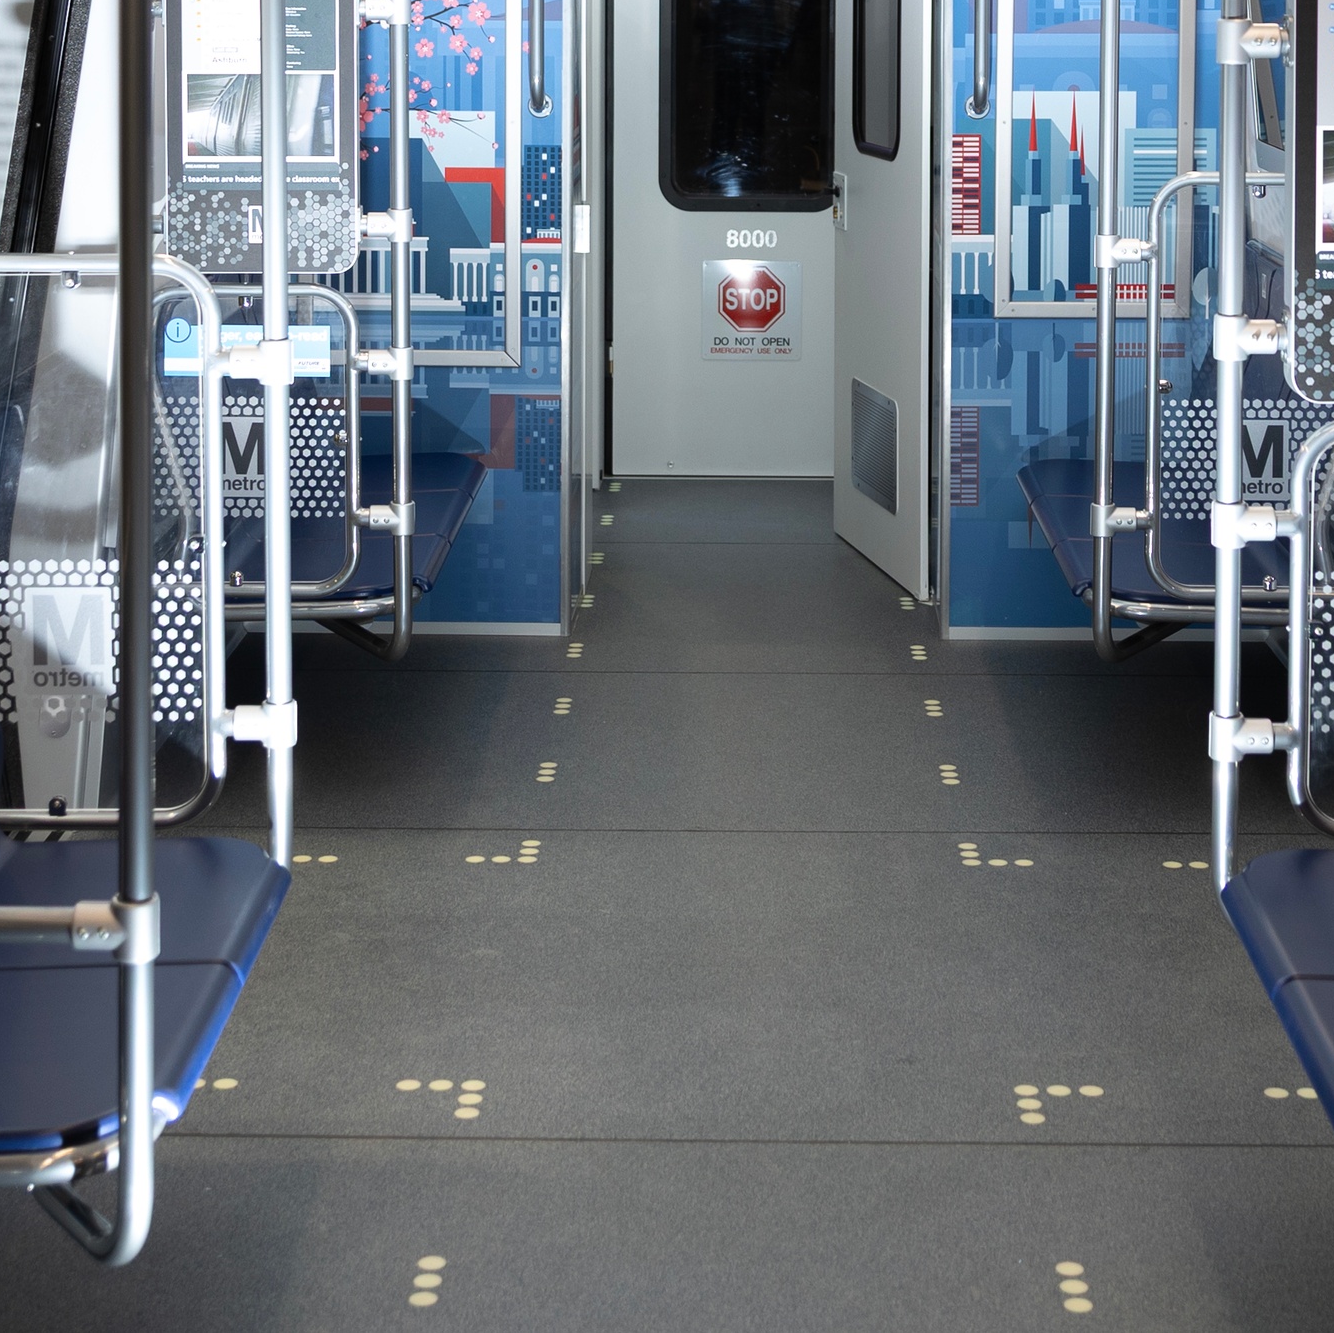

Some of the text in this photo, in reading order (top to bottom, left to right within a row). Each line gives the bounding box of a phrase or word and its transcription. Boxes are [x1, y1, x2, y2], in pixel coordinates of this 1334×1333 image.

[188, 175, 220, 183] teachers
[292, 175, 329, 183] classroom
[726, 230, 777, 248] 8000
[726, 289, 778, 311] STOP
[714, 337, 790, 347] DO NOT OPEN
